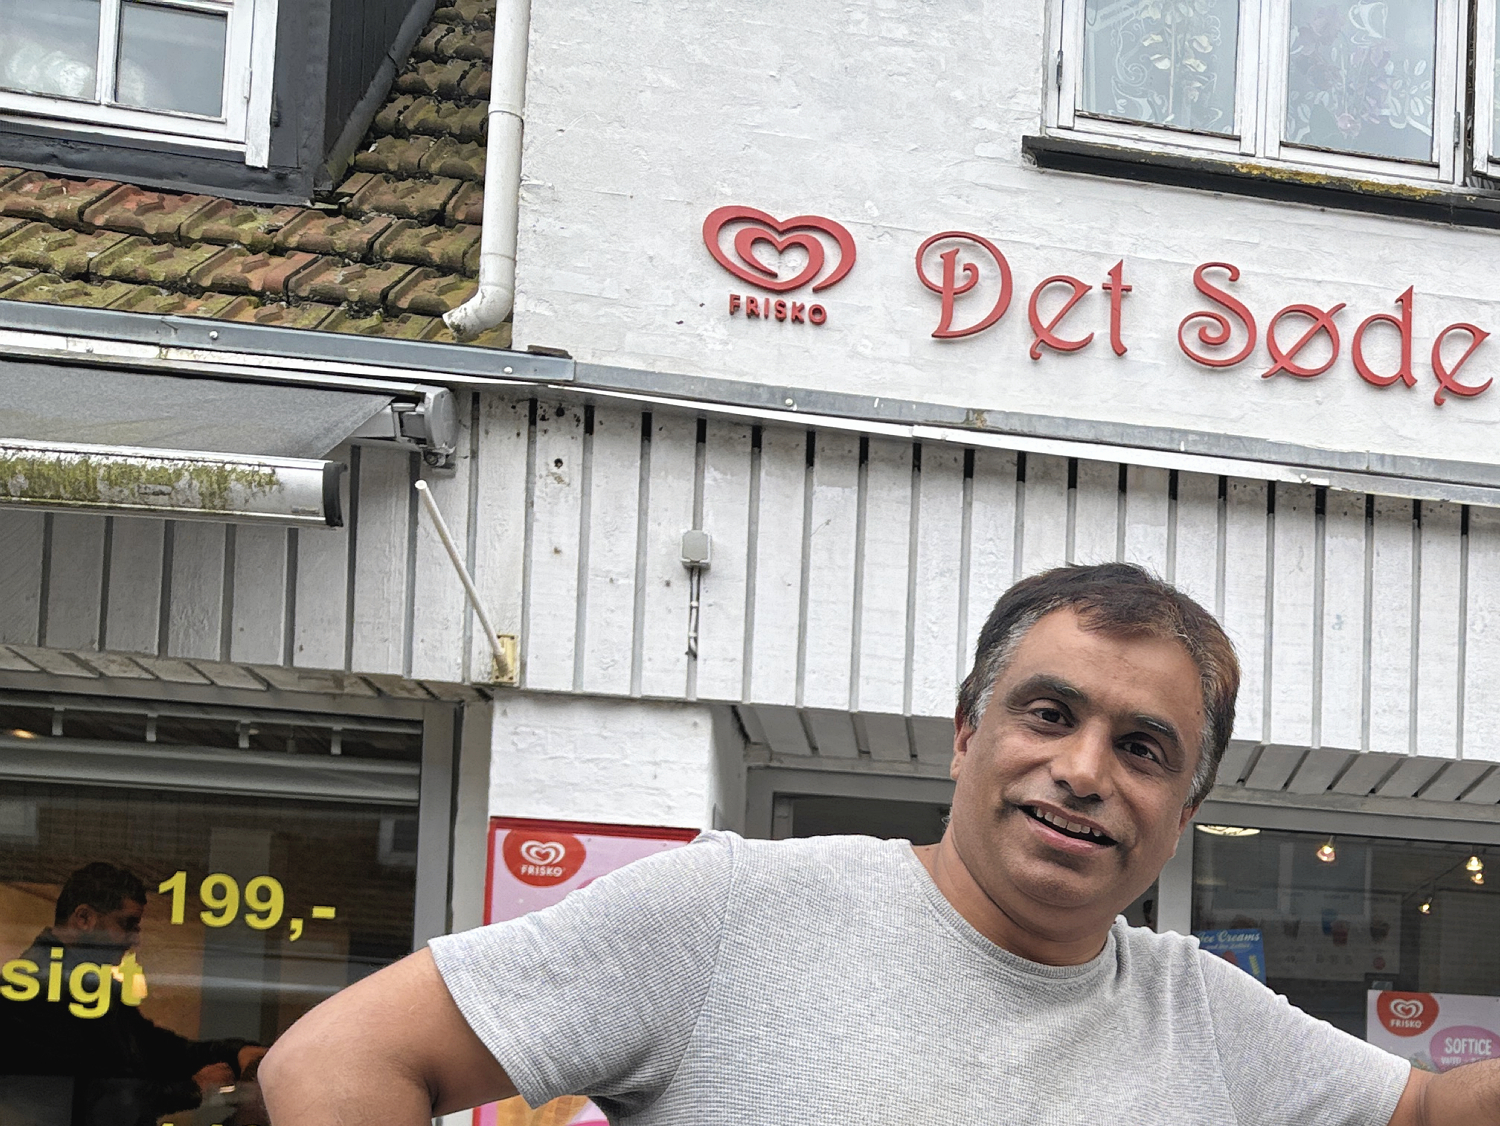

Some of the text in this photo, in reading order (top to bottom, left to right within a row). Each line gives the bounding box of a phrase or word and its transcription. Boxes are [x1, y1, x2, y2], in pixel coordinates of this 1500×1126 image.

[729, 293, 828, 325] FRISKO
[914, 230, 1133, 361] Det
[1177, 262, 1494, 406] Søde
[521, 865, 563, 877] FRISKO
[158, 871, 337, 943] 199,-
[1216, 929, 1260, 942] Creams
[0, 948, 149, 1019] sigt
[1390, 1019, 1422, 1028] FRISKO
[1444, 1037, 1493, 1055] SOFTICE
